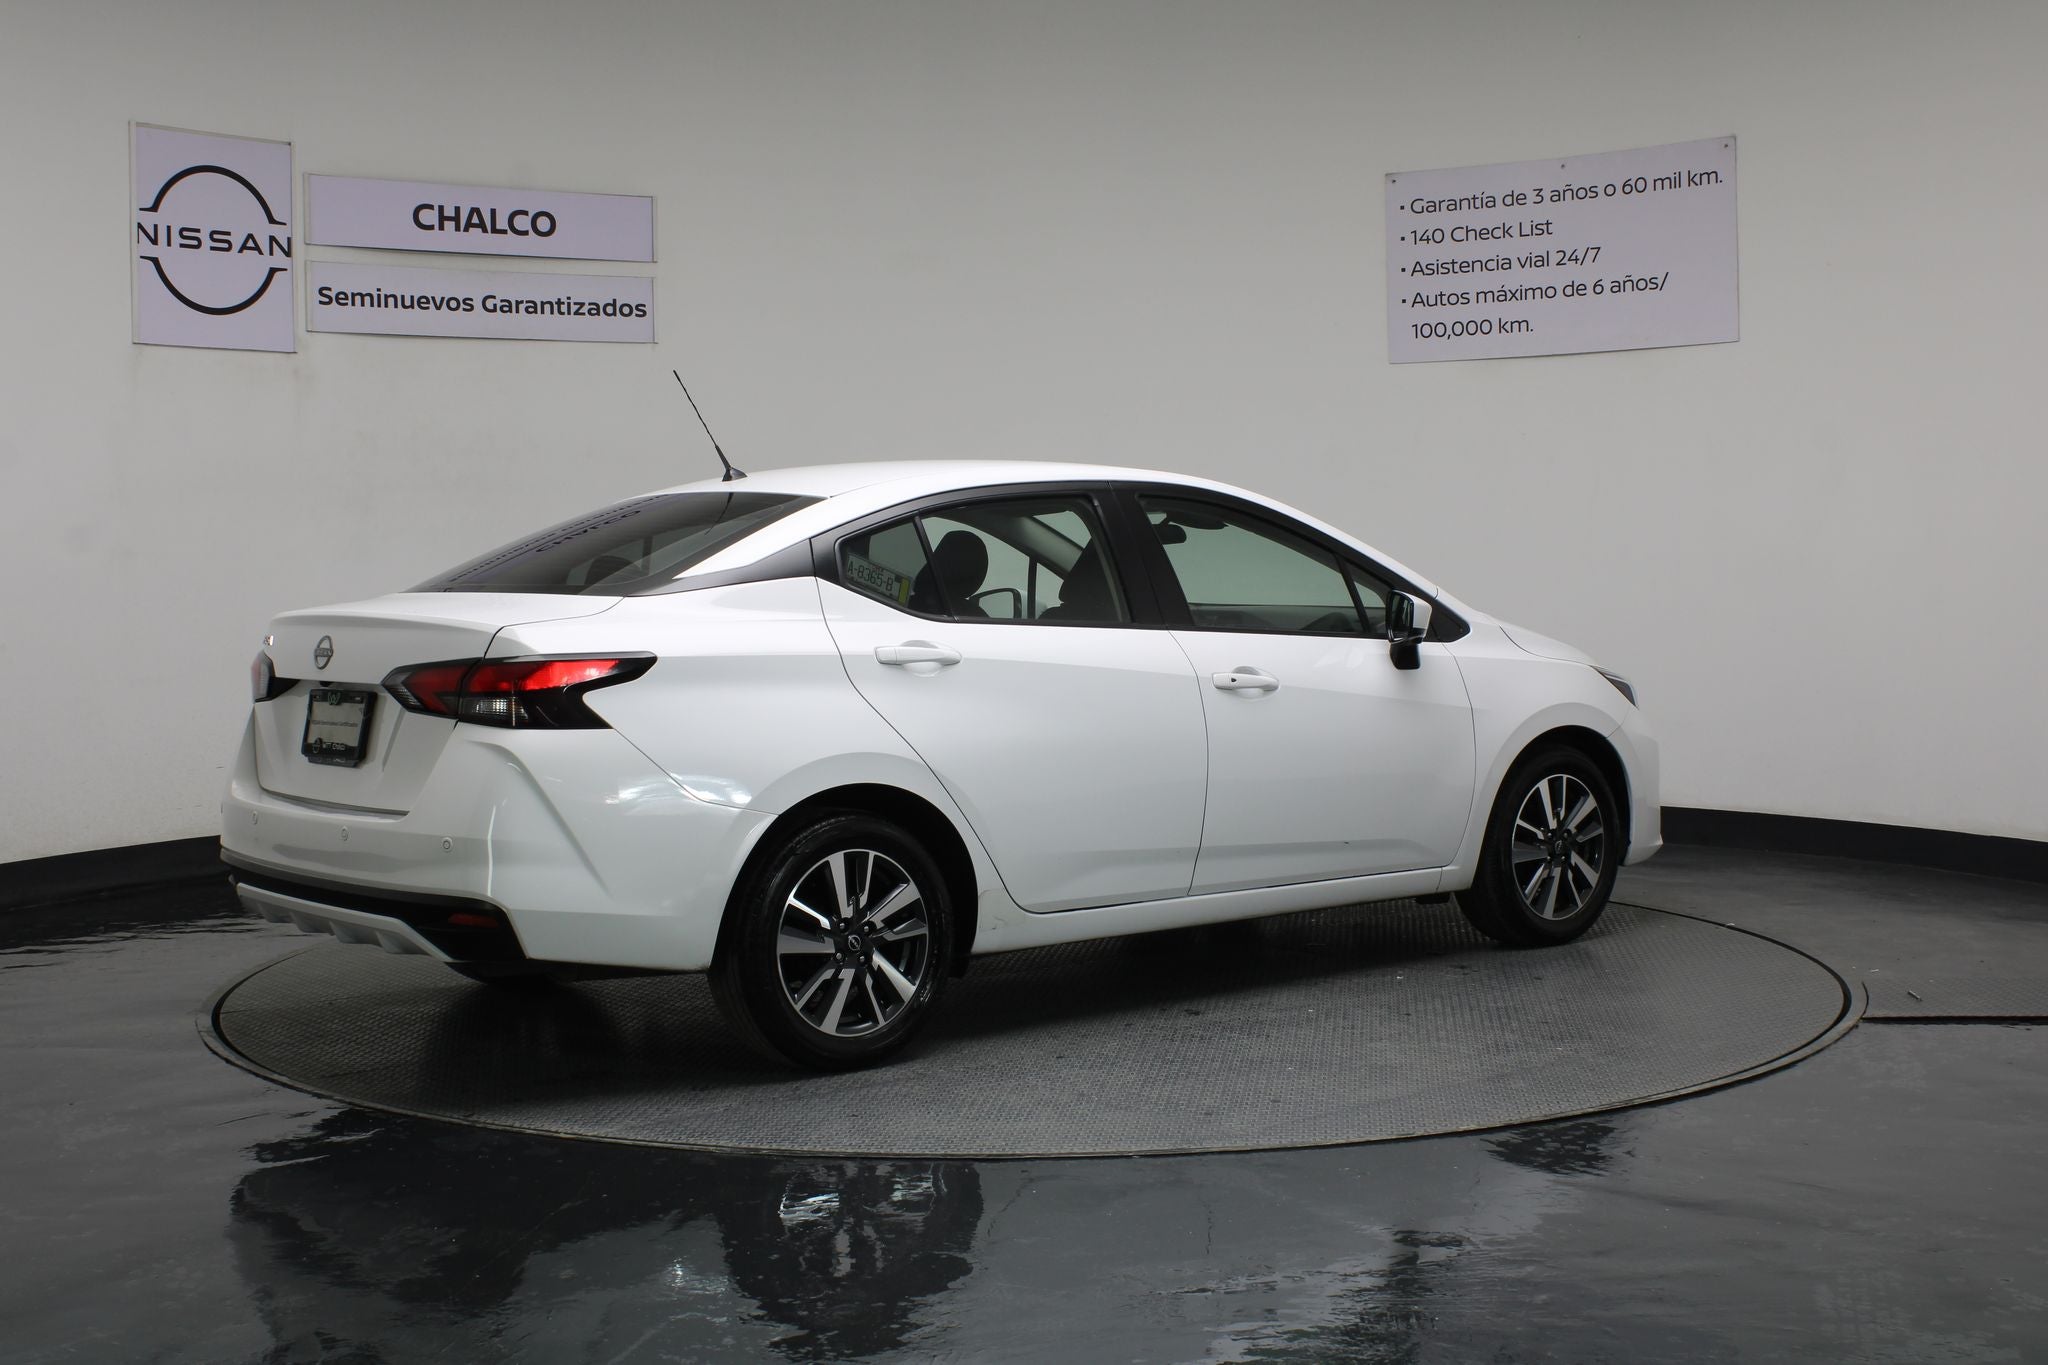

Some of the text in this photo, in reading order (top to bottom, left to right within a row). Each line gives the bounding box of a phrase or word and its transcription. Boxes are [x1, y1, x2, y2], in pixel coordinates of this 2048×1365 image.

[1410, 169, 1724, 215] Garantía de 3 años o 60 mil km.
[412, 203, 557, 238] CHALCO
[1410, 219, 1554, 246] 140 Check List
[136, 221, 293, 259] NISSAN
[1410, 246, 1602, 277] Asistencia vial 24/7
[317, 286, 648, 318] Seminuevos Garantizados
[1411, 271, 1670, 309] Autos máximo de 6 años/
[1411, 317, 1535, 341] 100,000 km.
